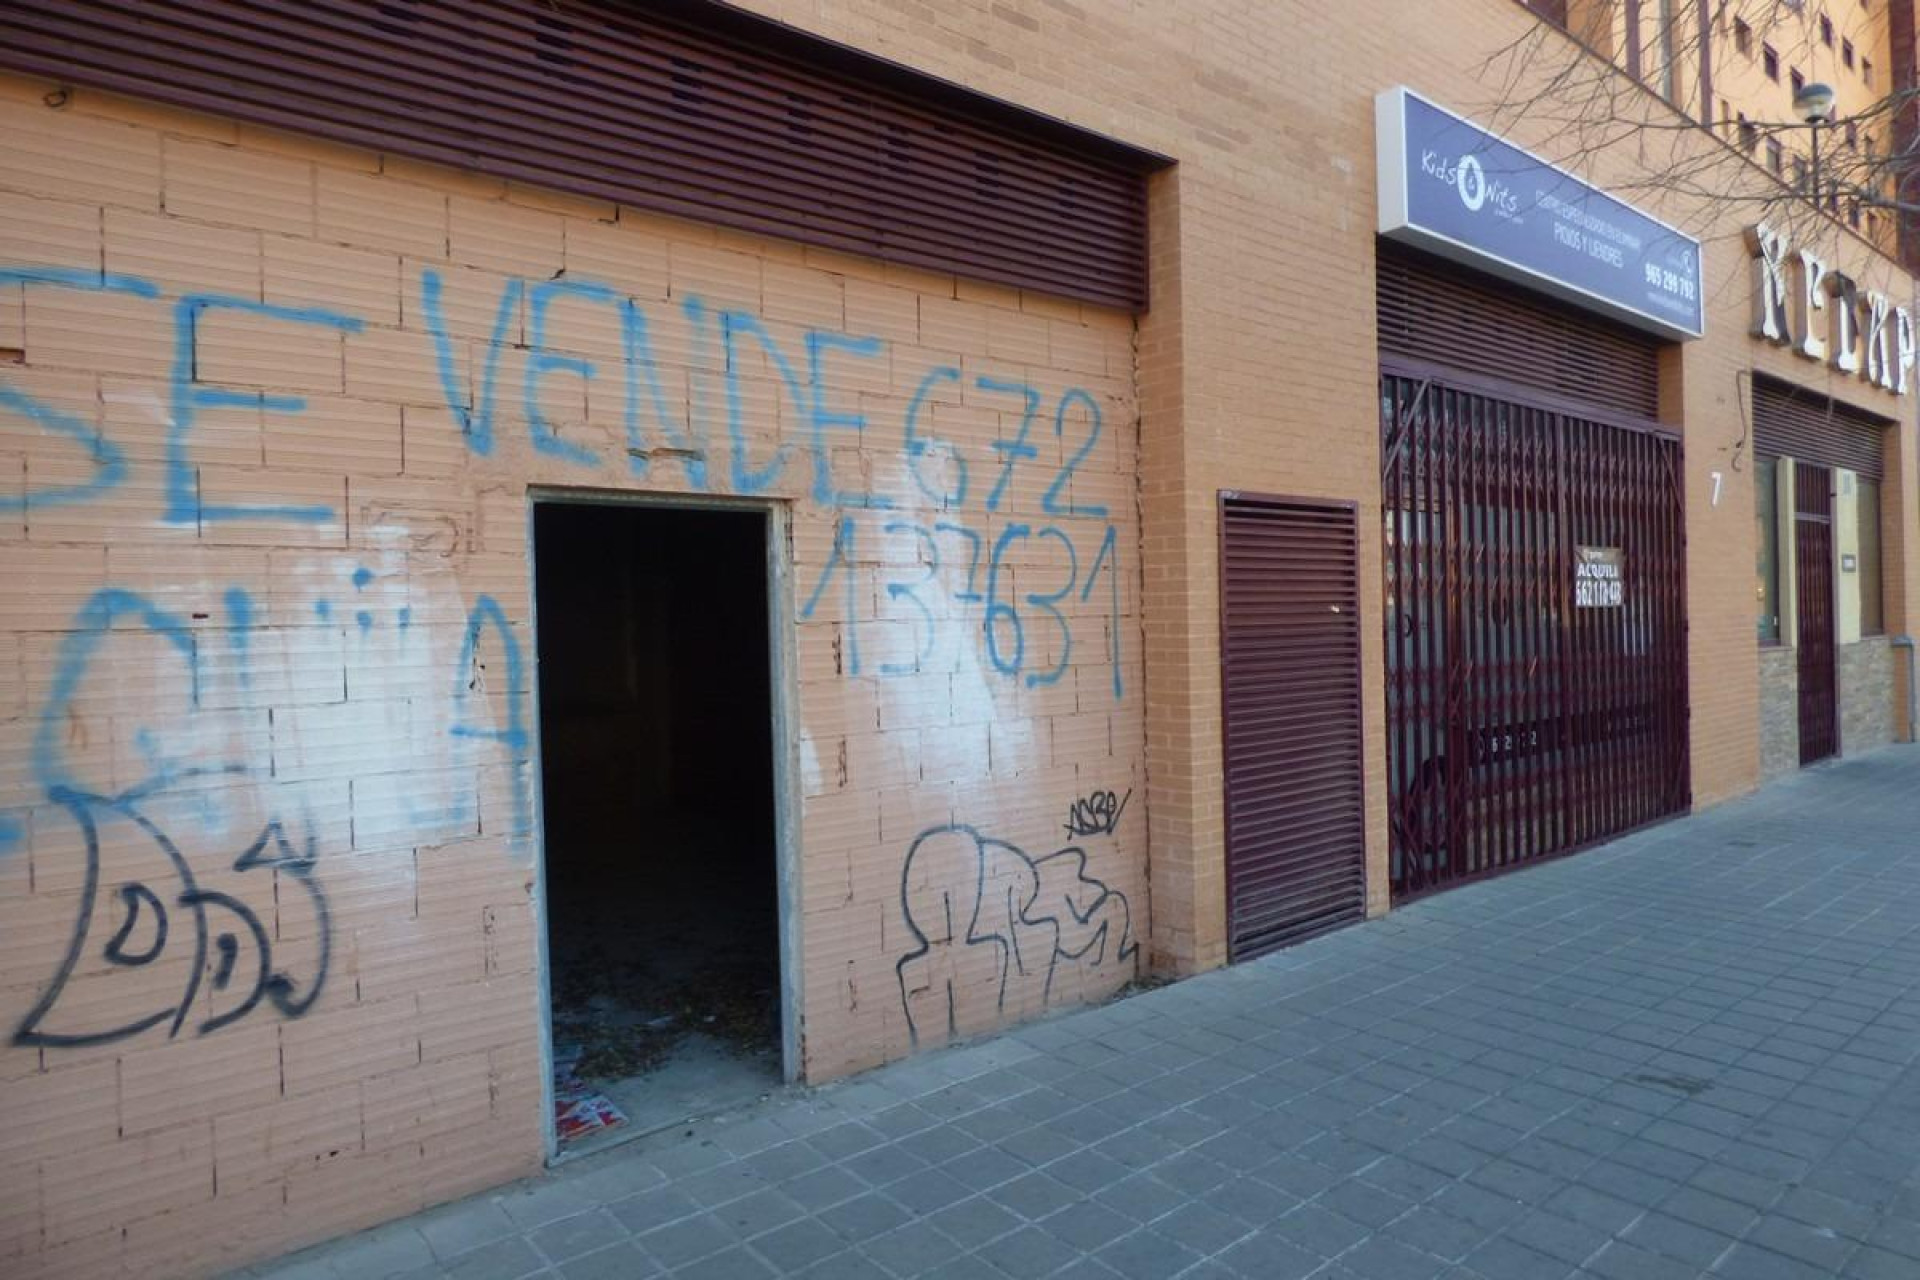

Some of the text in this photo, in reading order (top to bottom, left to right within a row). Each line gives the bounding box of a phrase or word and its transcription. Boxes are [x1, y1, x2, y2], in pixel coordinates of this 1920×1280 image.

[1420, 149, 1457, 186] Kids
[0, 267, 1108, 524] SE VENDE 672
[1710, 471, 1722, 506] 7
[802, 515, 1123, 700] 137631
